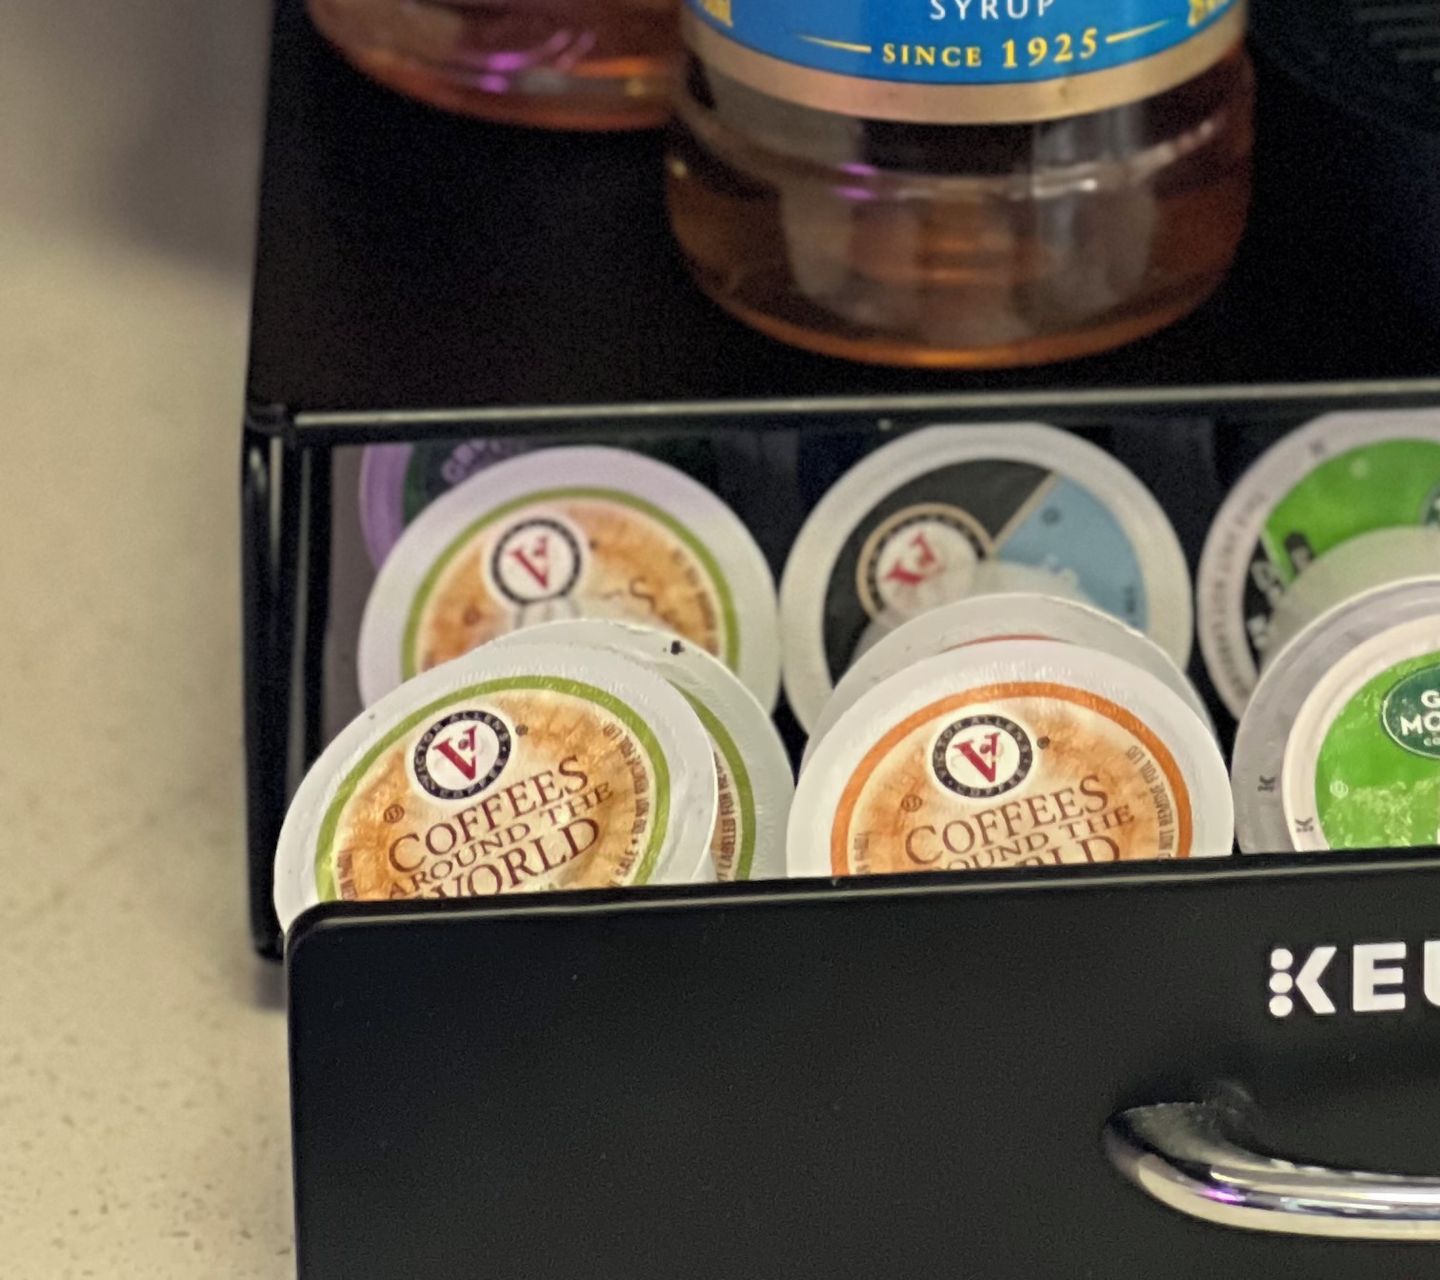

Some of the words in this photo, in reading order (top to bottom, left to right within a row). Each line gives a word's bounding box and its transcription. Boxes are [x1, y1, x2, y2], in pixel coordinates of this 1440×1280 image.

[882, 41, 983, 67] SINCE
[1001, 28, 1099, 68] 1925
[389, 755, 590, 873] COFFEES
[389, 822, 530, 899] AROUND
[541, 781, 614, 826] THE
[905, 775, 1109, 865] COFFEES
[1059, 804, 1135, 839] THE
